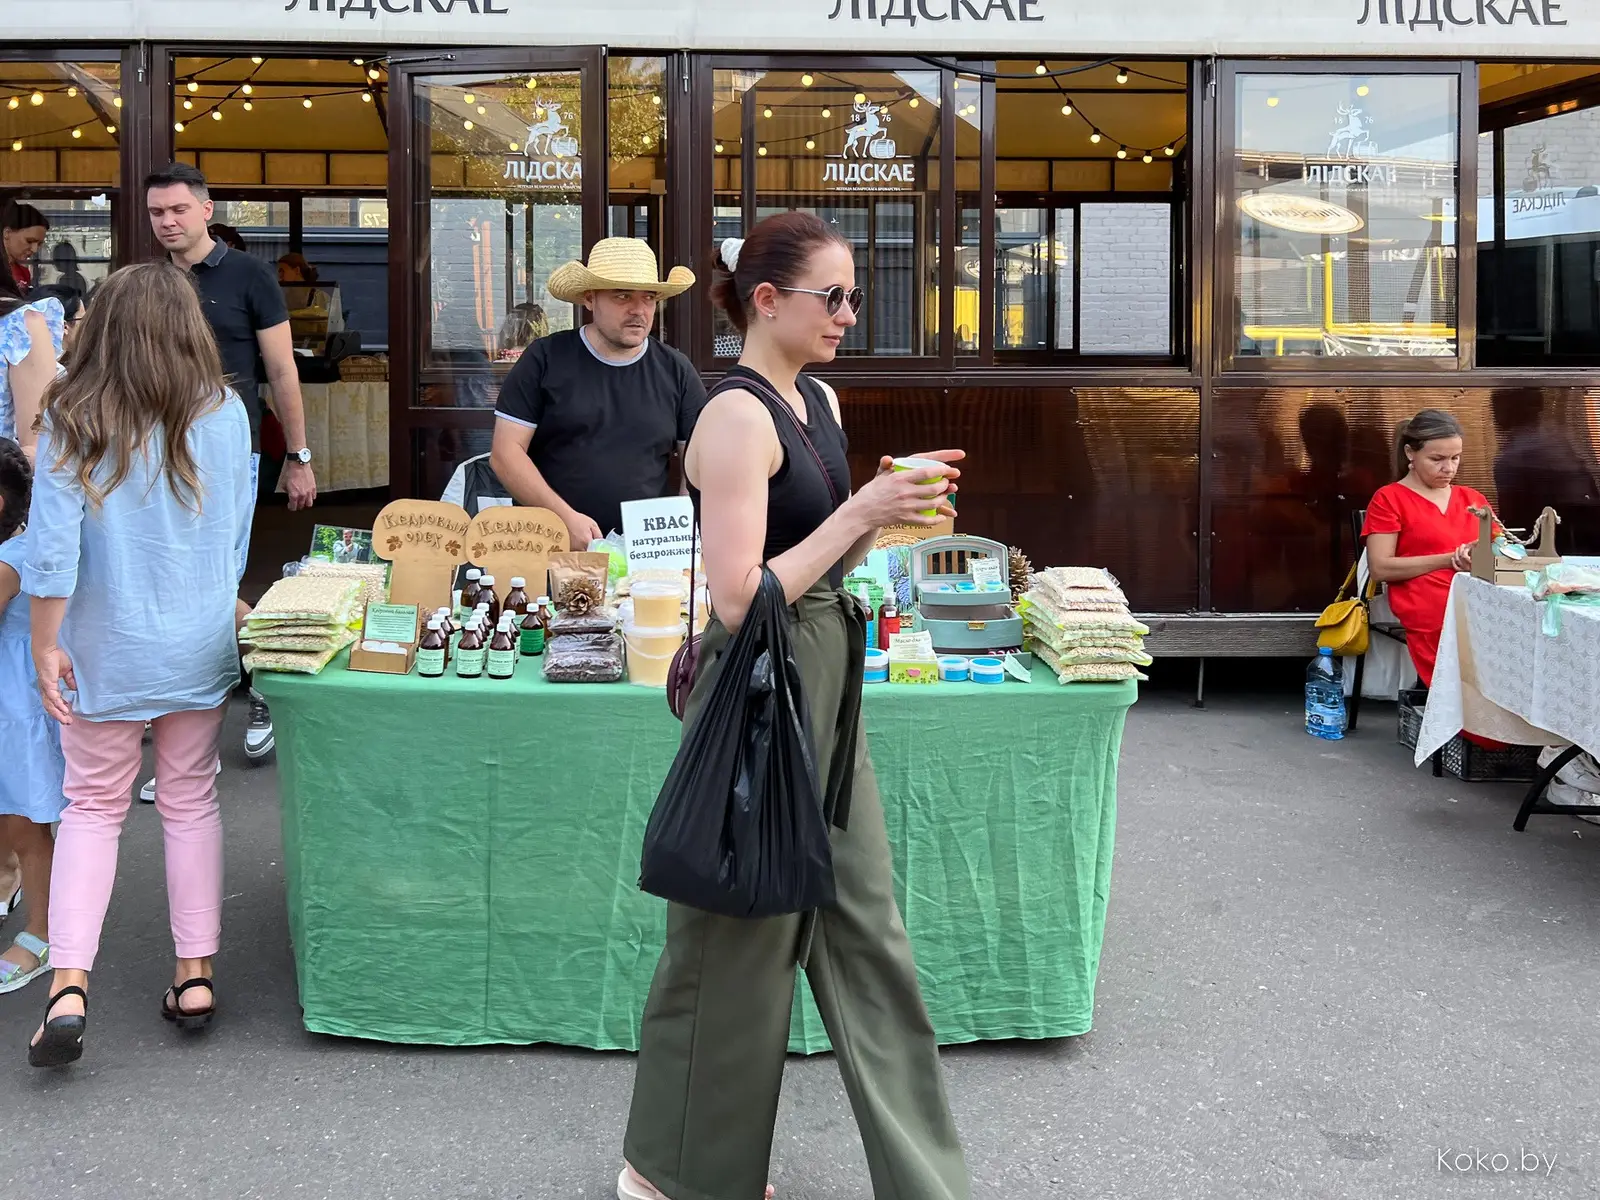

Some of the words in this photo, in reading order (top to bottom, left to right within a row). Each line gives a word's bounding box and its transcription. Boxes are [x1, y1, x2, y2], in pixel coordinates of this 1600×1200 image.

[850, 114, 860, 122] 18
[881, 114, 892, 122] 76
[822, 162, 915, 184] ЛІДСКАЕ
[476, 520, 564, 542] Кедровое
[643, 515, 690, 531] КВАС
[405, 530, 443, 549] орех
[492, 540, 544, 554] масло
